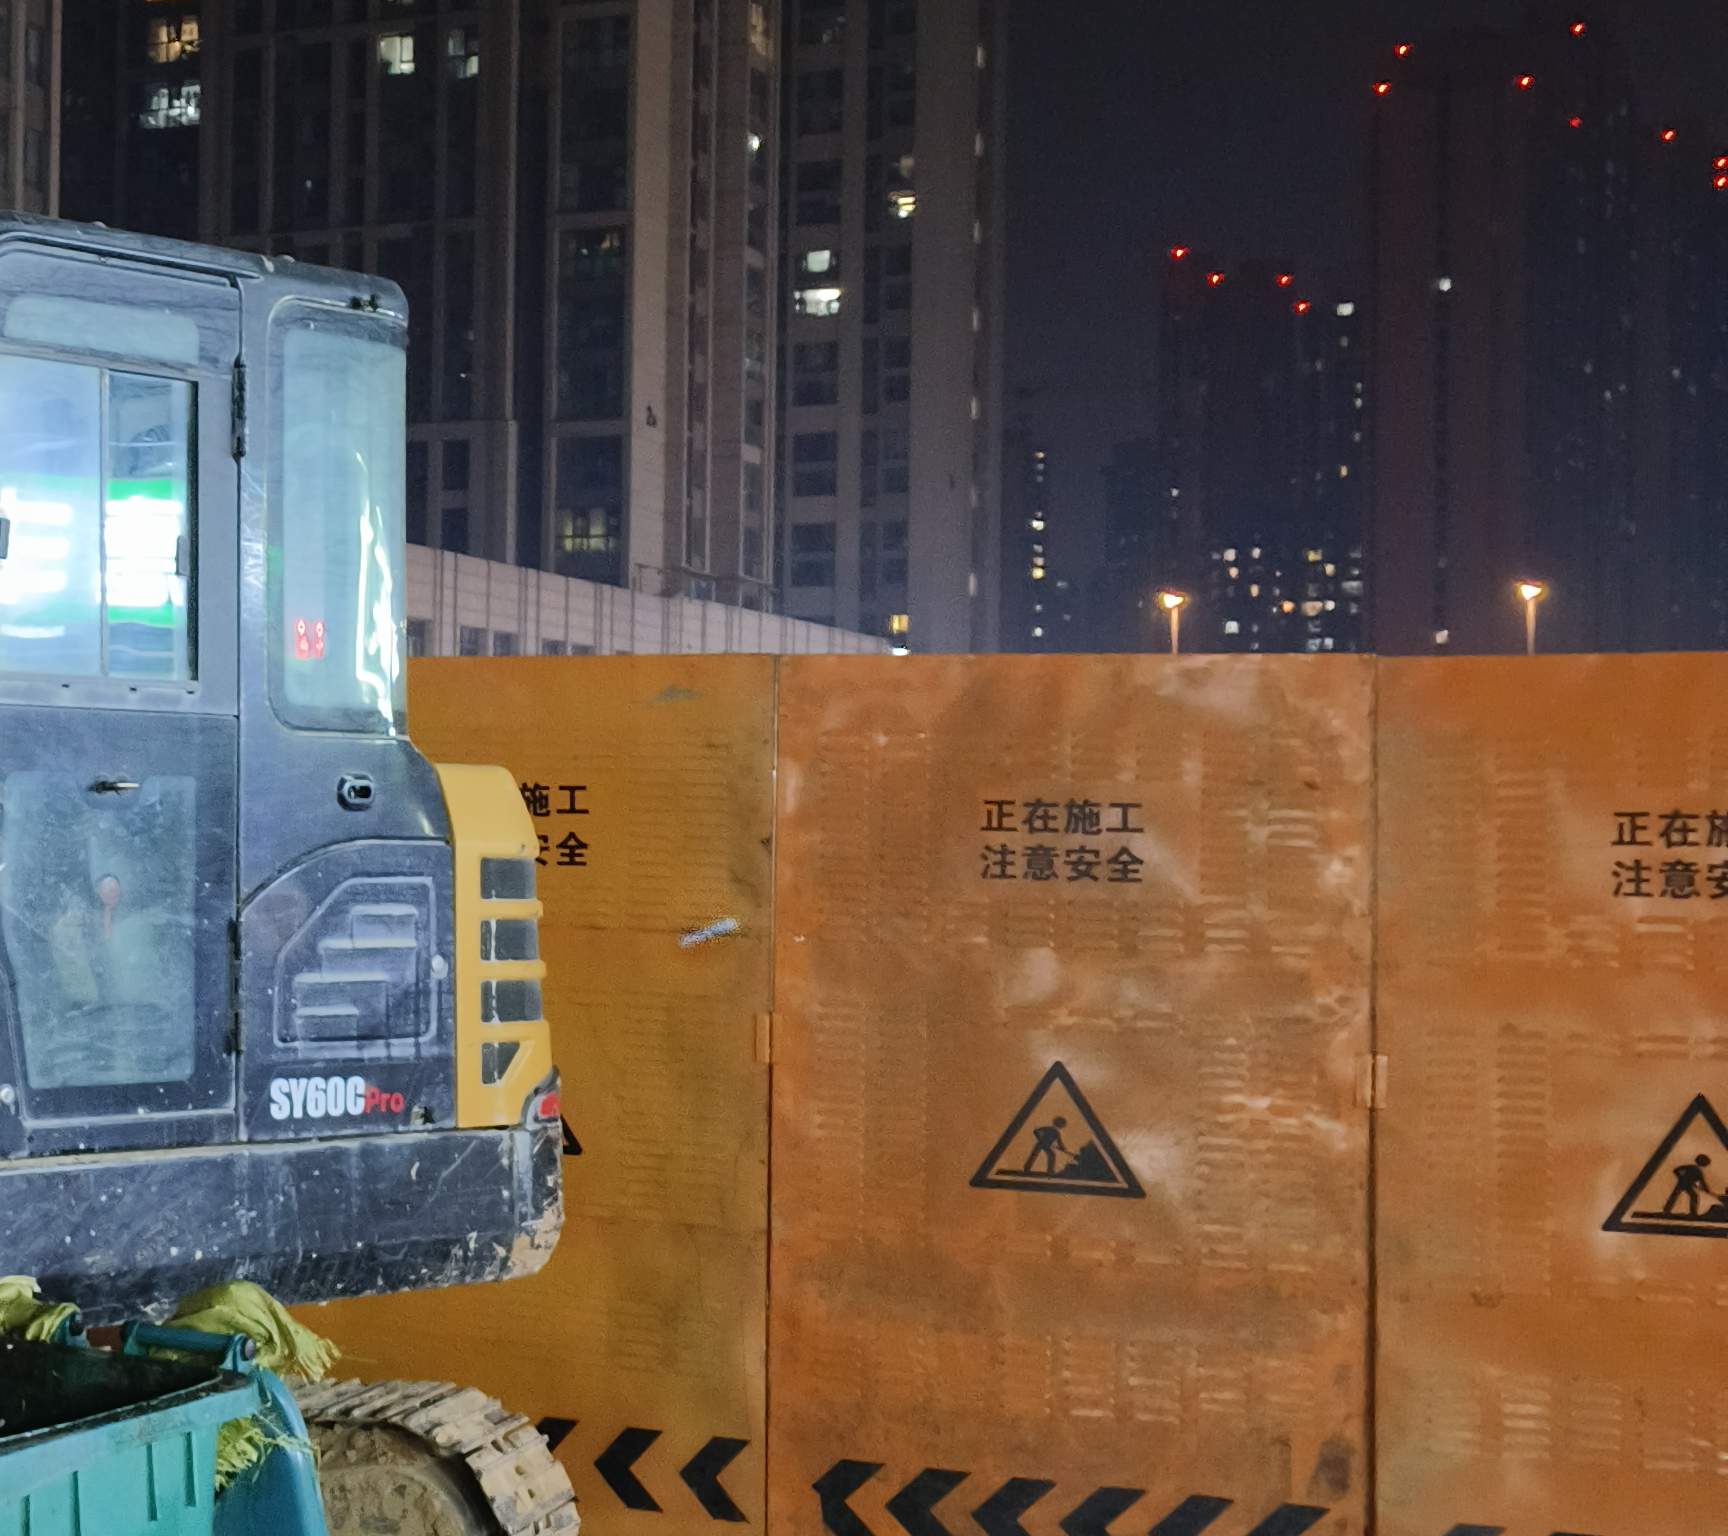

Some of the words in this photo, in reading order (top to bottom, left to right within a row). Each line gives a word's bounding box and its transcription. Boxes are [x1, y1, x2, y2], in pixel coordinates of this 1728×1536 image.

[980, 798, 1145, 835] 正在施工
[980, 843, 1145, 883] 注意安全
